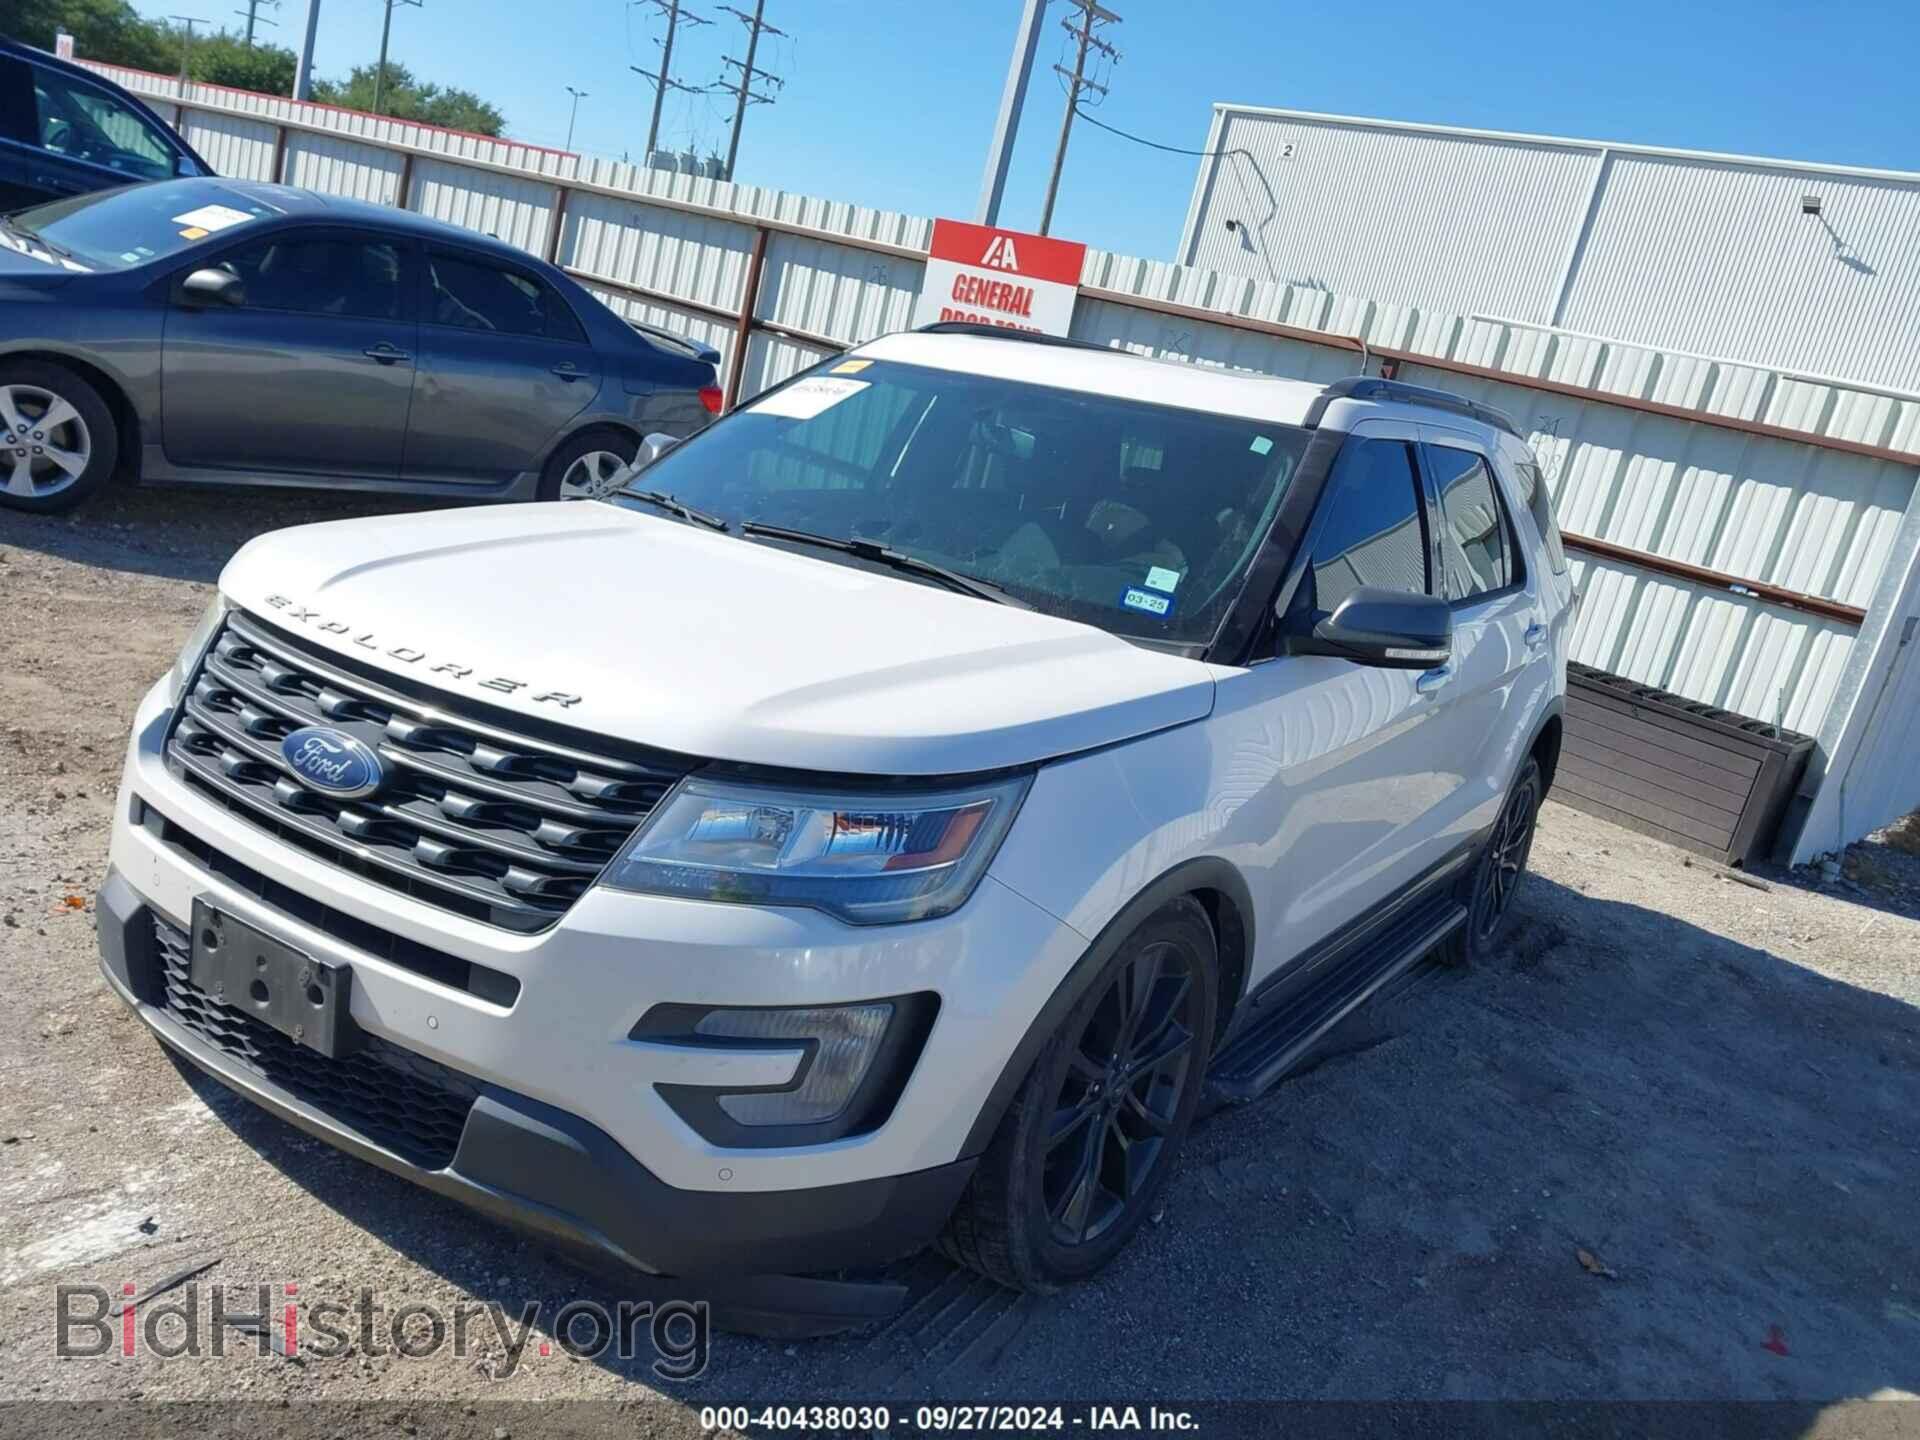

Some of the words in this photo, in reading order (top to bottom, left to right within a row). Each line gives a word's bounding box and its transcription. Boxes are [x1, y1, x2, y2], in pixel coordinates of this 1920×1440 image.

[1283, 145, 1293, 156] 2
[951, 273, 1034, 317] GENERAL
[1128, 594, 1164, 609] 03-25
[264, 594, 583, 707] EXPLORER
[293, 737, 353, 782] Ford
